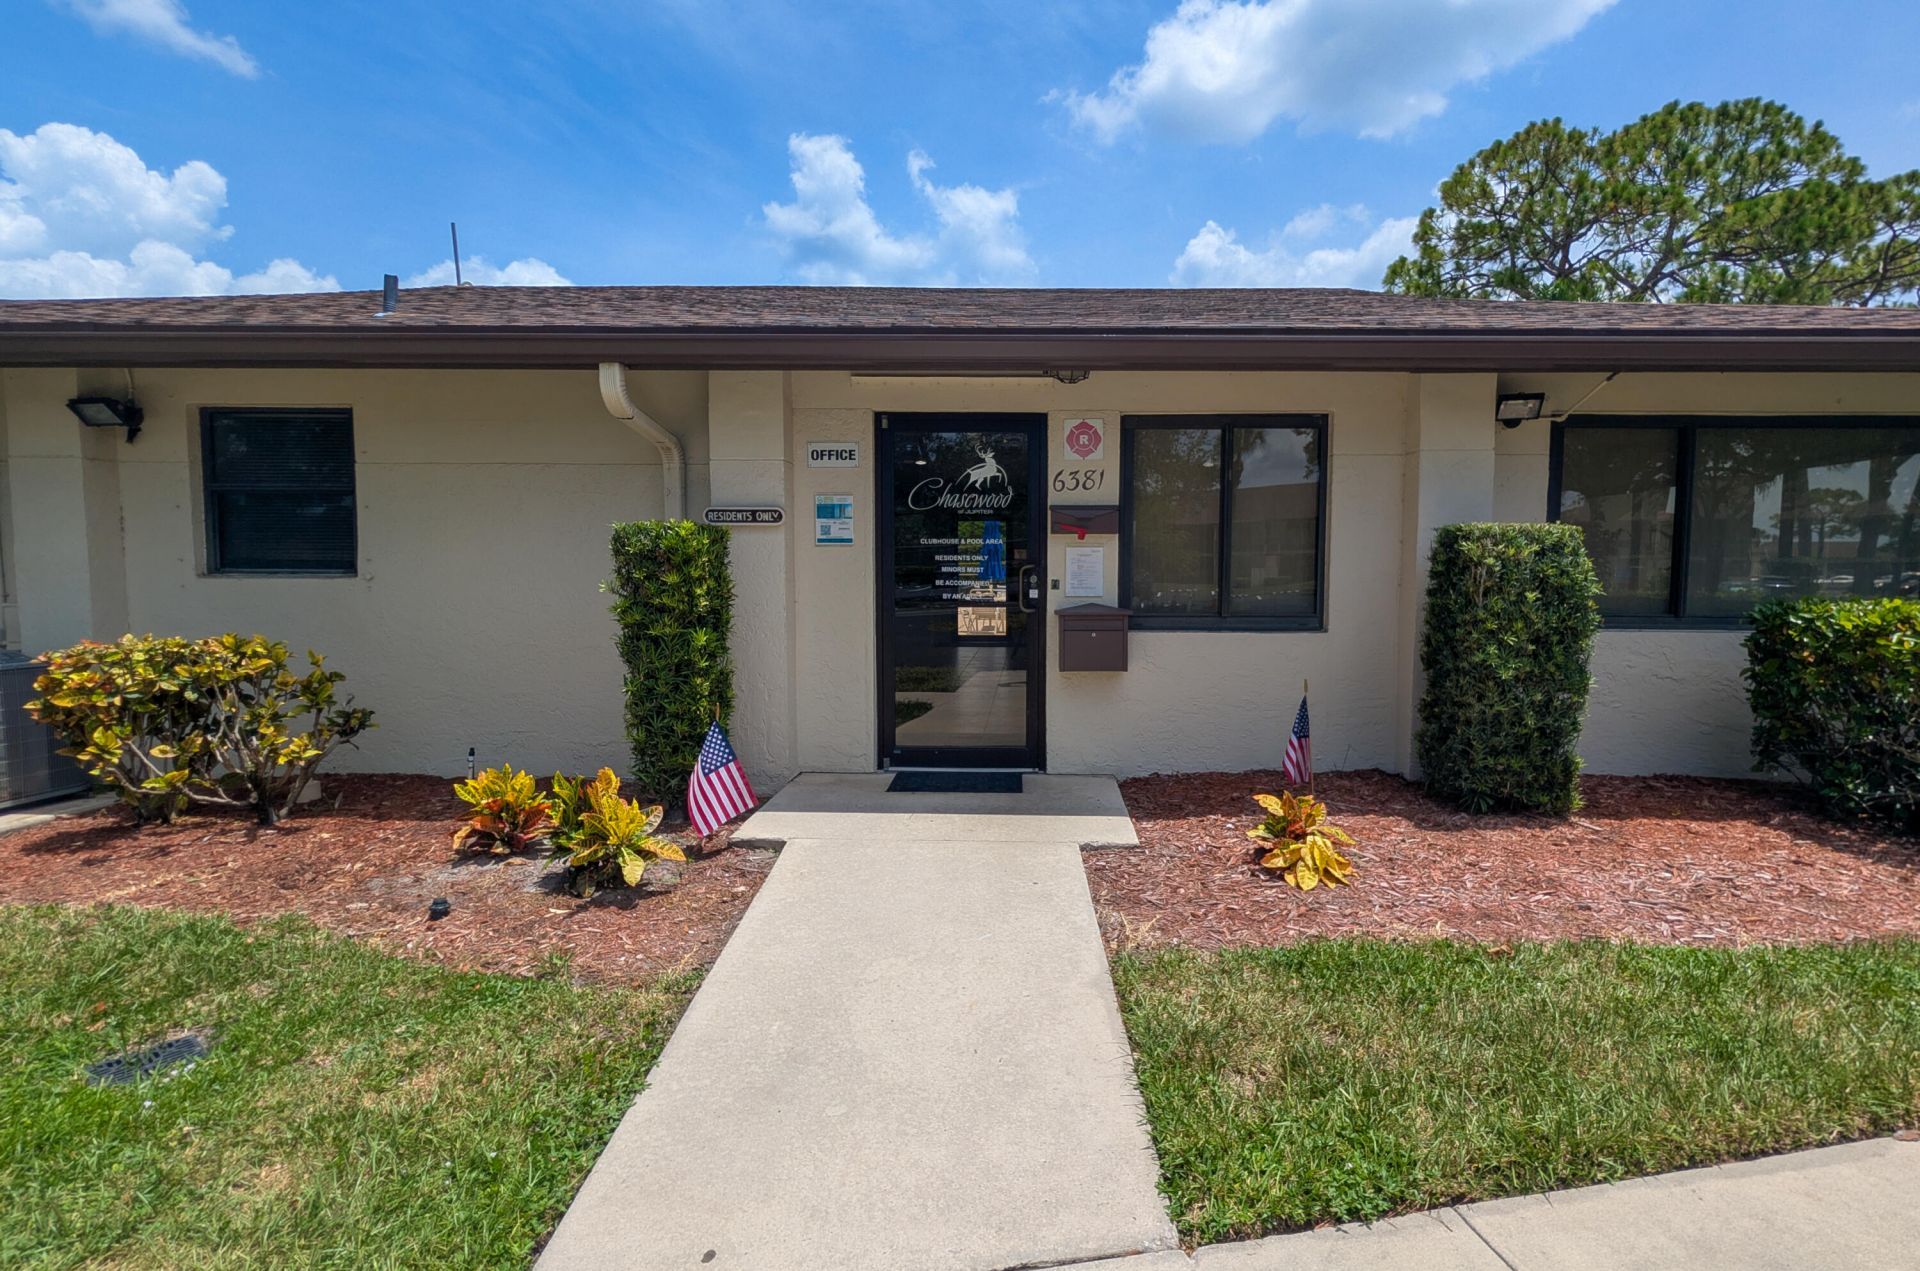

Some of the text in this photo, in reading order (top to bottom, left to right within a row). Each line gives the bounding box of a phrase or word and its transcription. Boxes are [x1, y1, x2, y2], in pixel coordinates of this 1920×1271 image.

[1080, 435, 1089, 445] R
[811, 449, 856, 461] OFFICE
[1053, 469, 1105, 493] 6381
[908, 477, 1013, 511] Chasewood
[707, 511, 779, 521] RESIDENTS ONLY
